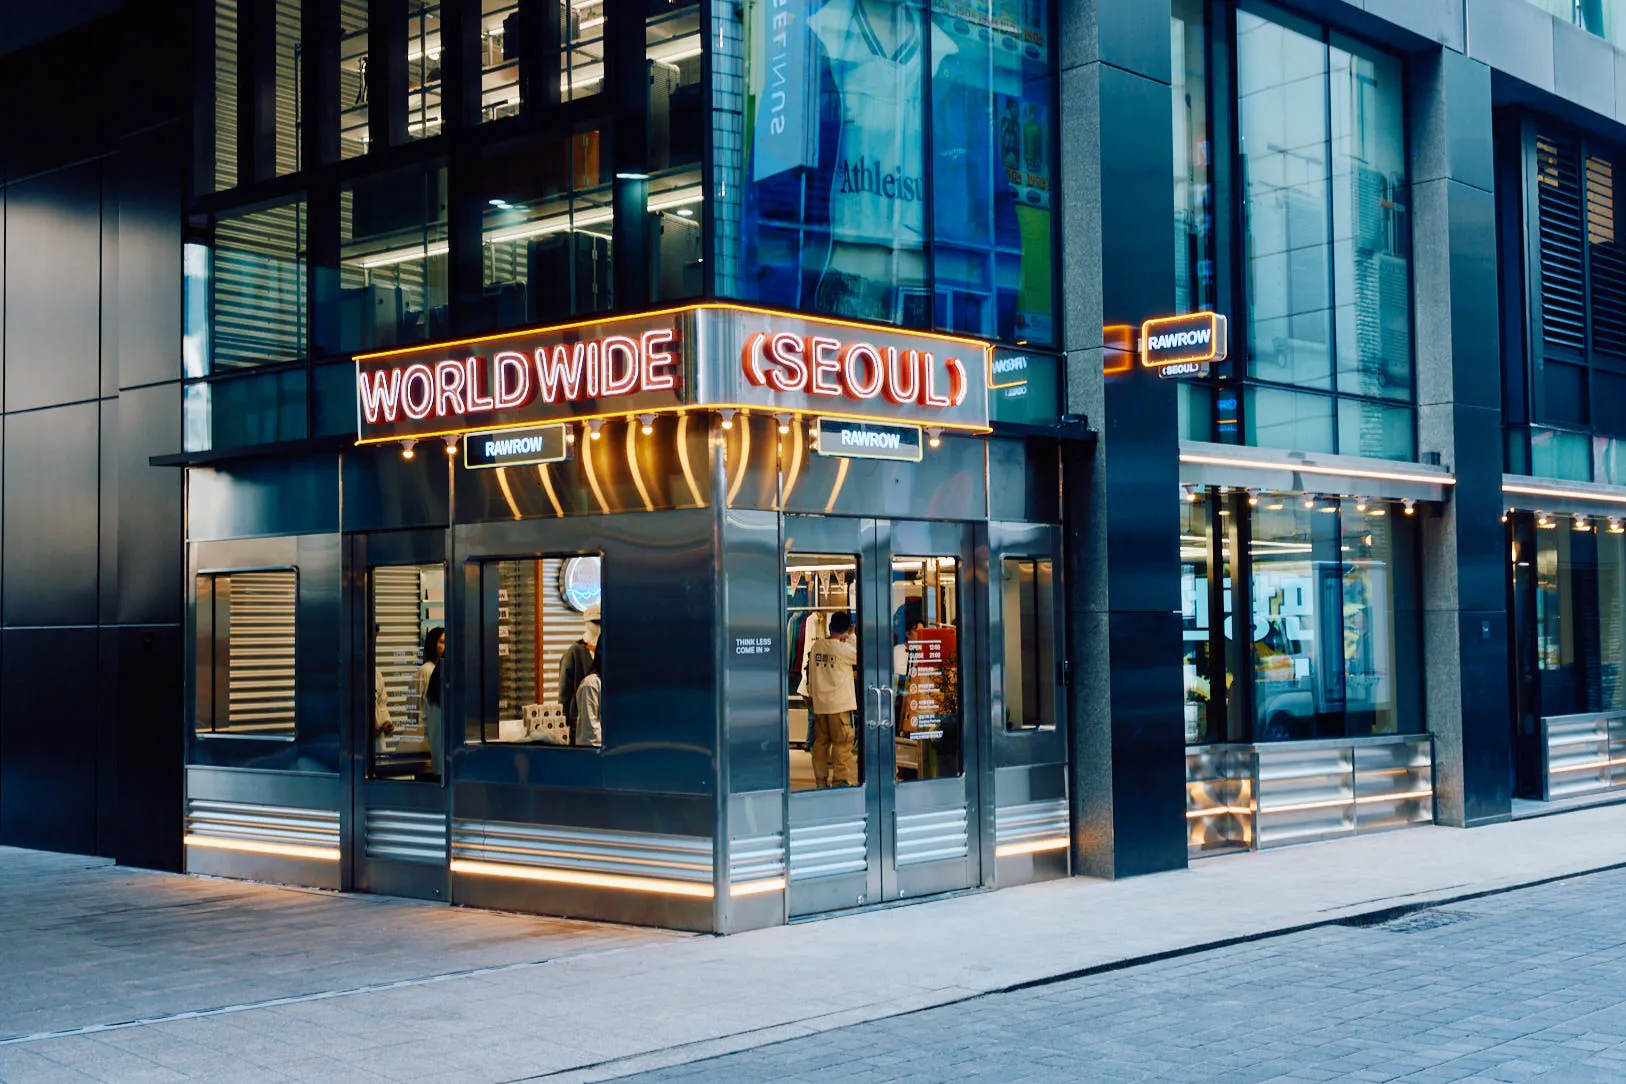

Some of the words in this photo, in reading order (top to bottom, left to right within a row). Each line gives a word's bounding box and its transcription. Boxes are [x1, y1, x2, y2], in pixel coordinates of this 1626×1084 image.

[1147, 329, 1211, 351] RAWROW
[741, 331, 968, 408] (SEOUL)
[485, 436, 543, 458] RAWROW
[841, 429, 900, 449] RAWROW
[735, 638, 755, 646] THINK
[756, 638, 772, 646] LESS
[735, 646, 755, 654] COME
[756, 646, 763, 654] IN
